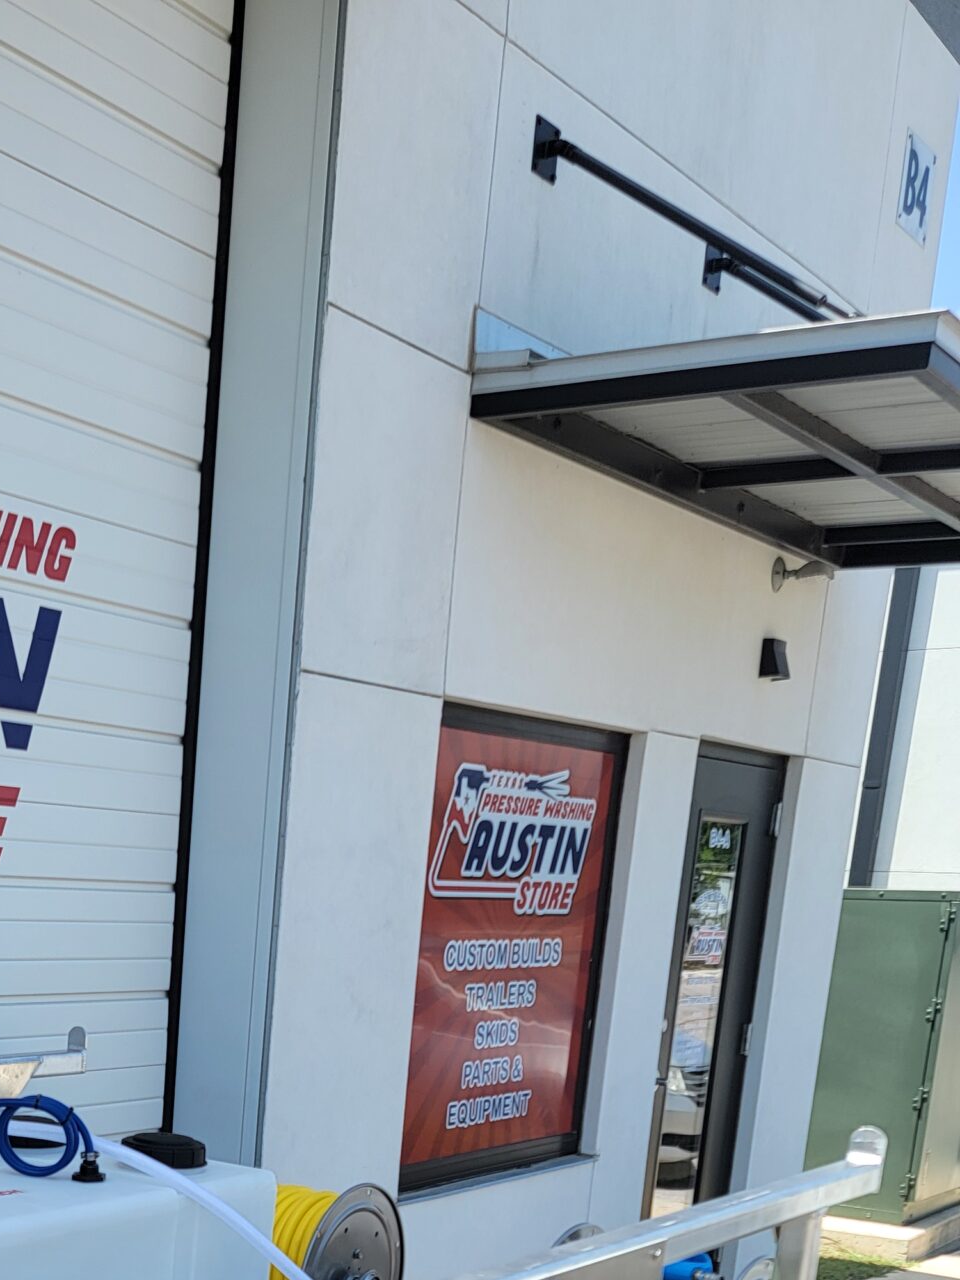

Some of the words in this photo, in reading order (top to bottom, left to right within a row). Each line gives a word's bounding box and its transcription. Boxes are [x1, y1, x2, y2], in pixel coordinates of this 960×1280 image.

[903, 148, 930, 228] B4
[490, 774, 524, 789] TEXAS
[481, 793, 543, 817] PRESSURE
[543, 800, 595, 822] WASHING
[464, 820, 589, 875] AUSTIN
[517, 881, 575, 910] STORE
[445, 940, 508, 969] CUSTOM
[511, 939, 561, 967] BUILDS
[466, 982, 536, 1010] TRAILERS
[475, 1020, 519, 1048] SKIDS
[462, 1059, 511, 1087] PARTS
[512, 1056, 523, 1081] &
[447, 1091, 531, 1128] EQUIPMENT
